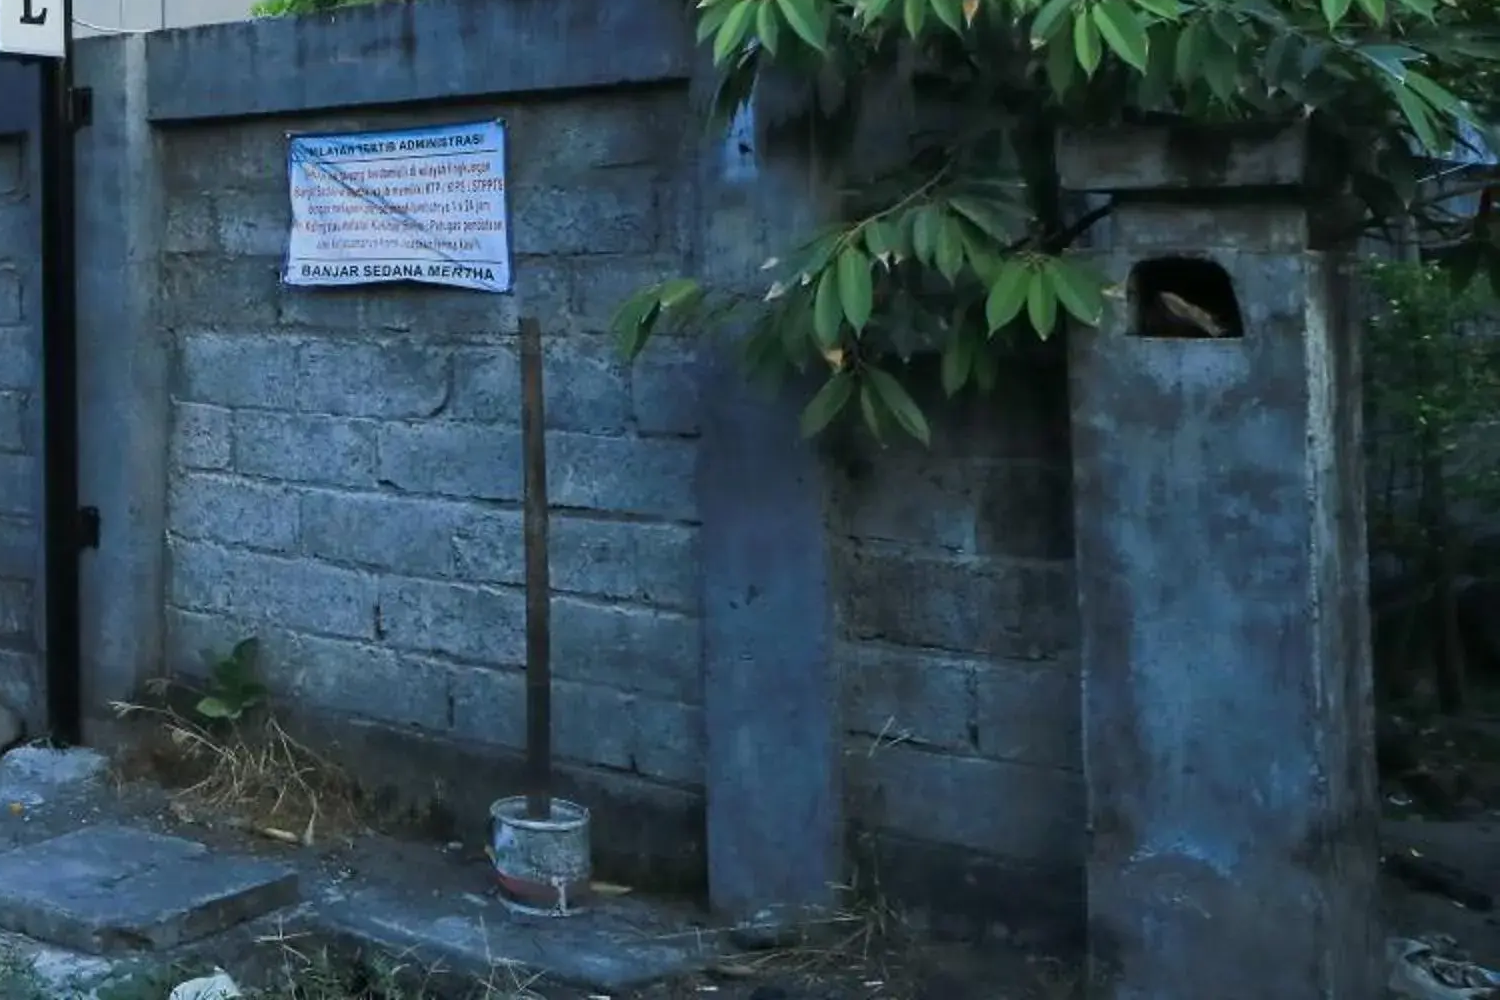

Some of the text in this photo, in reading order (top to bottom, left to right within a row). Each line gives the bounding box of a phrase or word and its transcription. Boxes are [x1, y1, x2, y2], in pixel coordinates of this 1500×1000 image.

[301, 264, 495, 281] BANJAR SEDANA MERTHA
